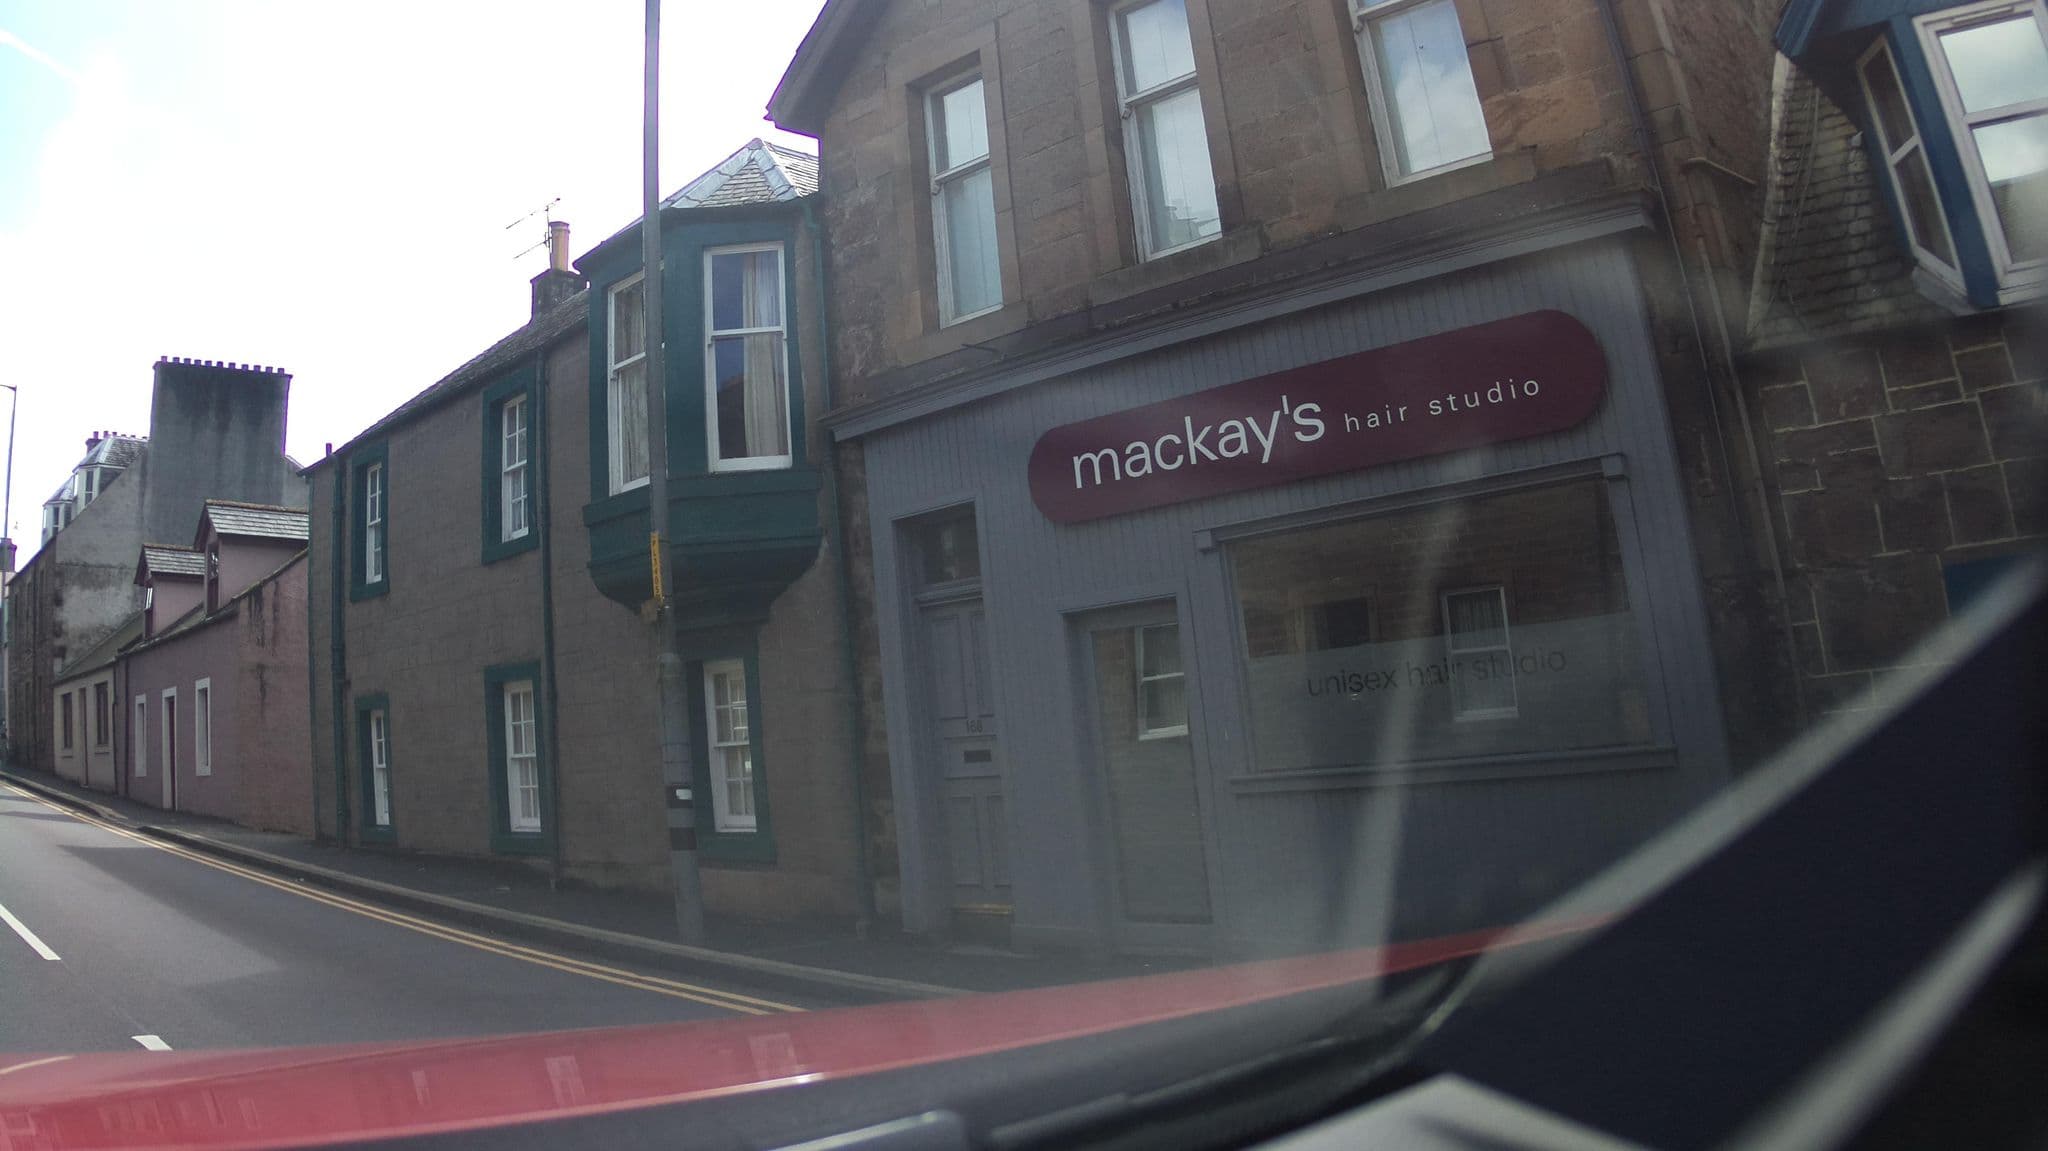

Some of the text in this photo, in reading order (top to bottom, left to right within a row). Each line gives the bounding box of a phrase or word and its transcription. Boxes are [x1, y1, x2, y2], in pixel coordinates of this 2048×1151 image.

[1072, 378, 1541, 488] mackay's hair studio
[1307, 648, 1567, 697] unisex hair studio
